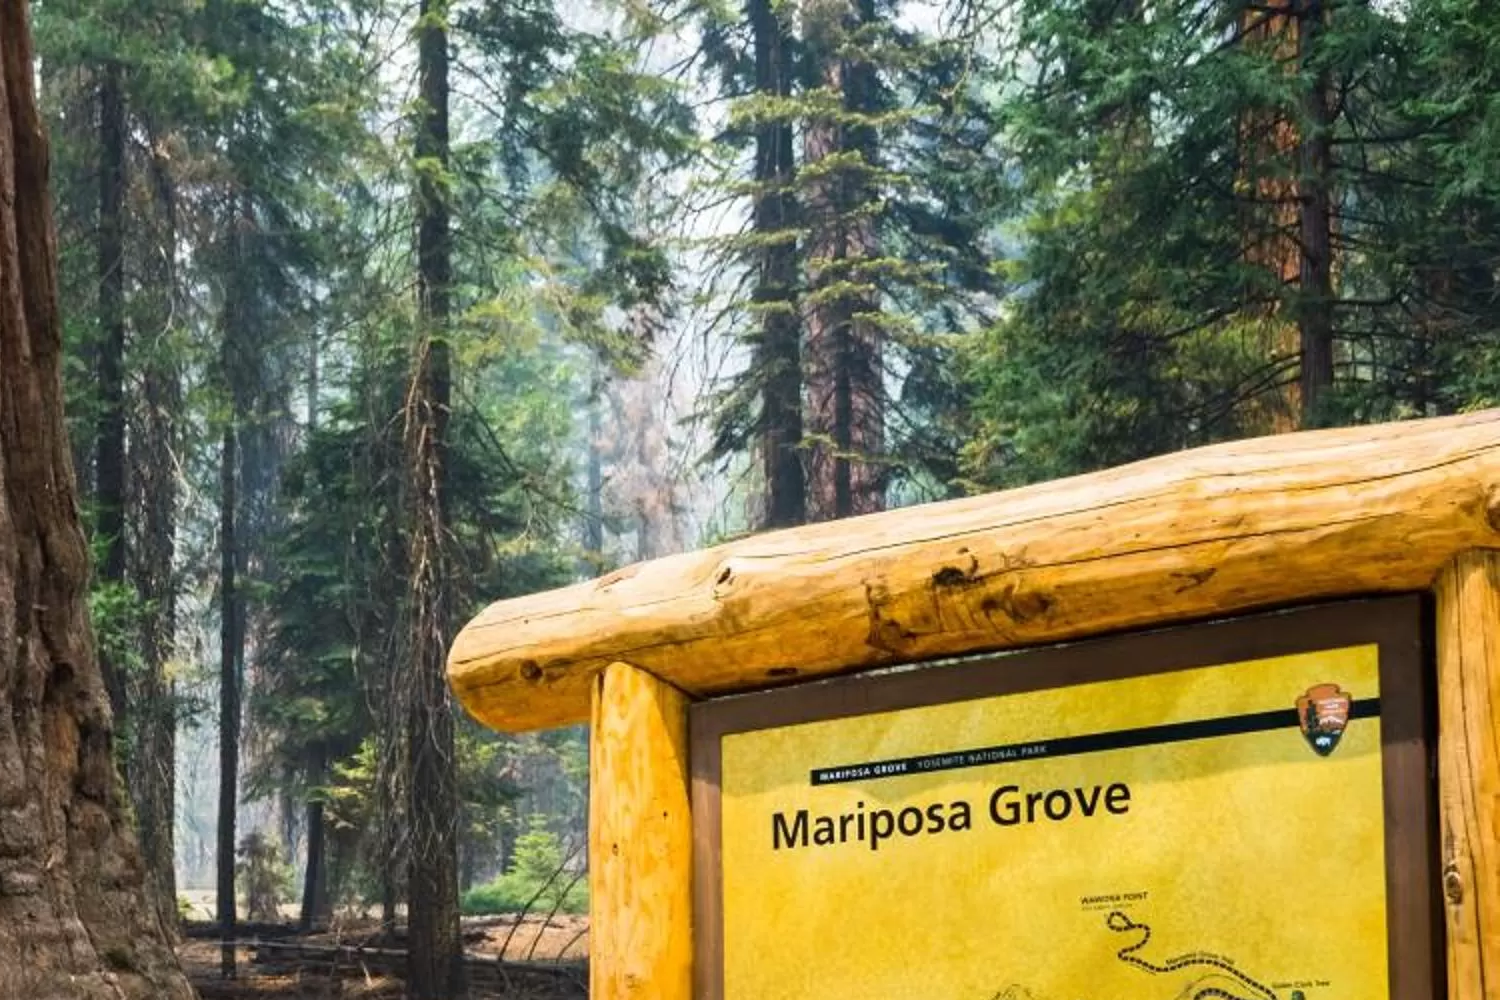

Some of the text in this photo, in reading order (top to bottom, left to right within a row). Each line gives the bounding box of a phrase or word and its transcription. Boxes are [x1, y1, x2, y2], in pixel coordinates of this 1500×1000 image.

[818, 745, 1048, 781] MARIPOSA GROVE YOSEMITE NATIONAL PARK
[771, 781, 1132, 851] Mariposa Grove
